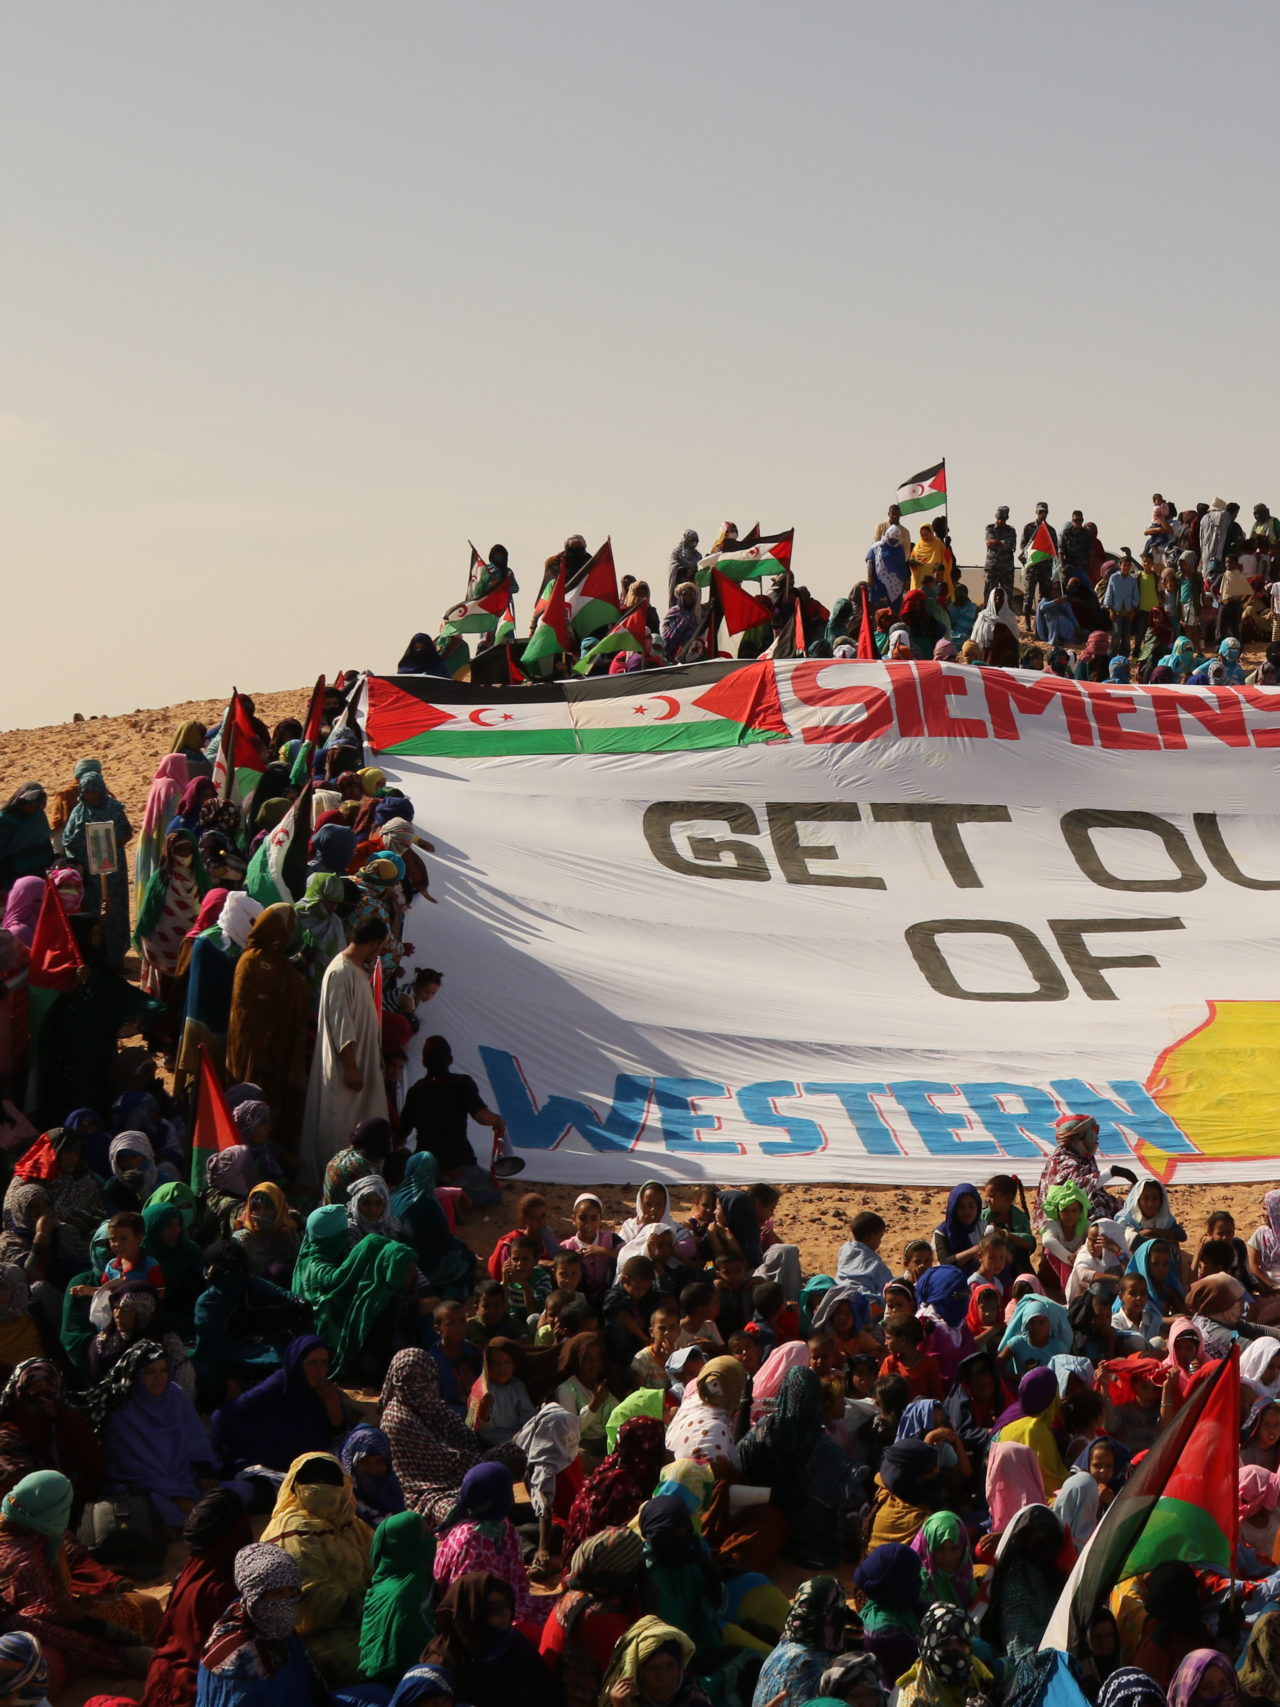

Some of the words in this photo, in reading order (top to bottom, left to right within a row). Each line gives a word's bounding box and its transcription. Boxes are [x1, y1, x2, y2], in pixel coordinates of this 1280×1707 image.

[643, 801, 1012, 890] GET
[904, 916, 1187, 1003] OF
[478, 1044, 1204, 1160] WESTERN
